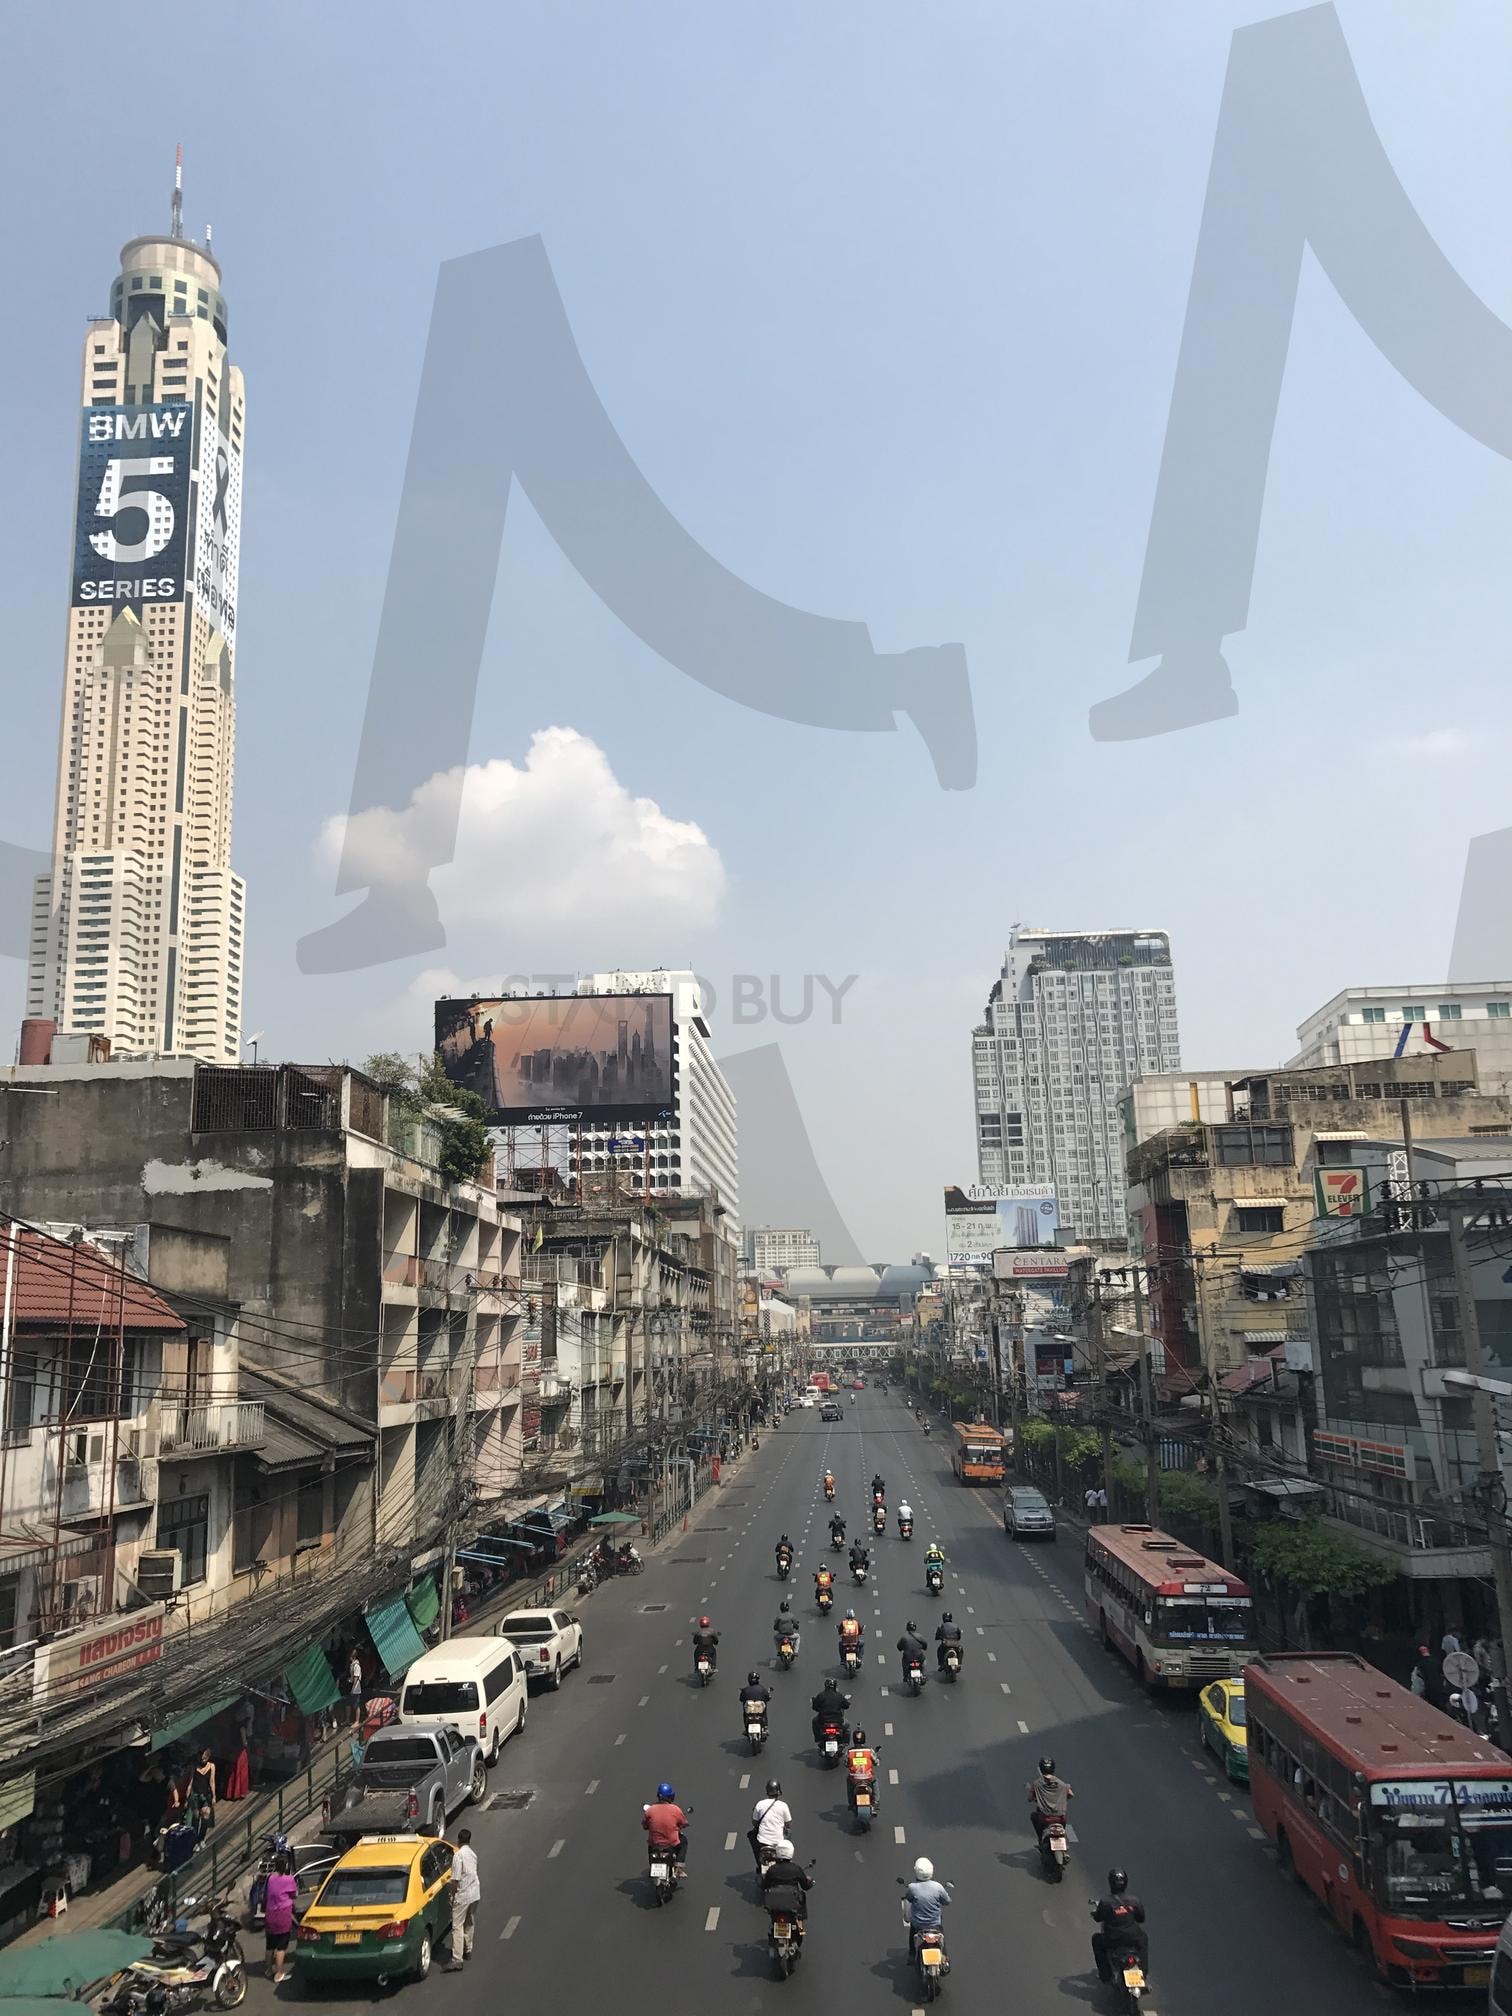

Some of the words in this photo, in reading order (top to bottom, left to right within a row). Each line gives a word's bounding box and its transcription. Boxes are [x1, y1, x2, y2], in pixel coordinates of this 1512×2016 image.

[88, 411, 186, 441] BMW
[88, 456, 175, 563] 5
[79, 577, 176, 600] SERIES
[552, 1112, 577, 1120] iPhone
[577, 1111, 583, 1119] 7
[949, 1252, 971, 1261] 1720
[1013, 1255, 1067, 1266] CENTARA
